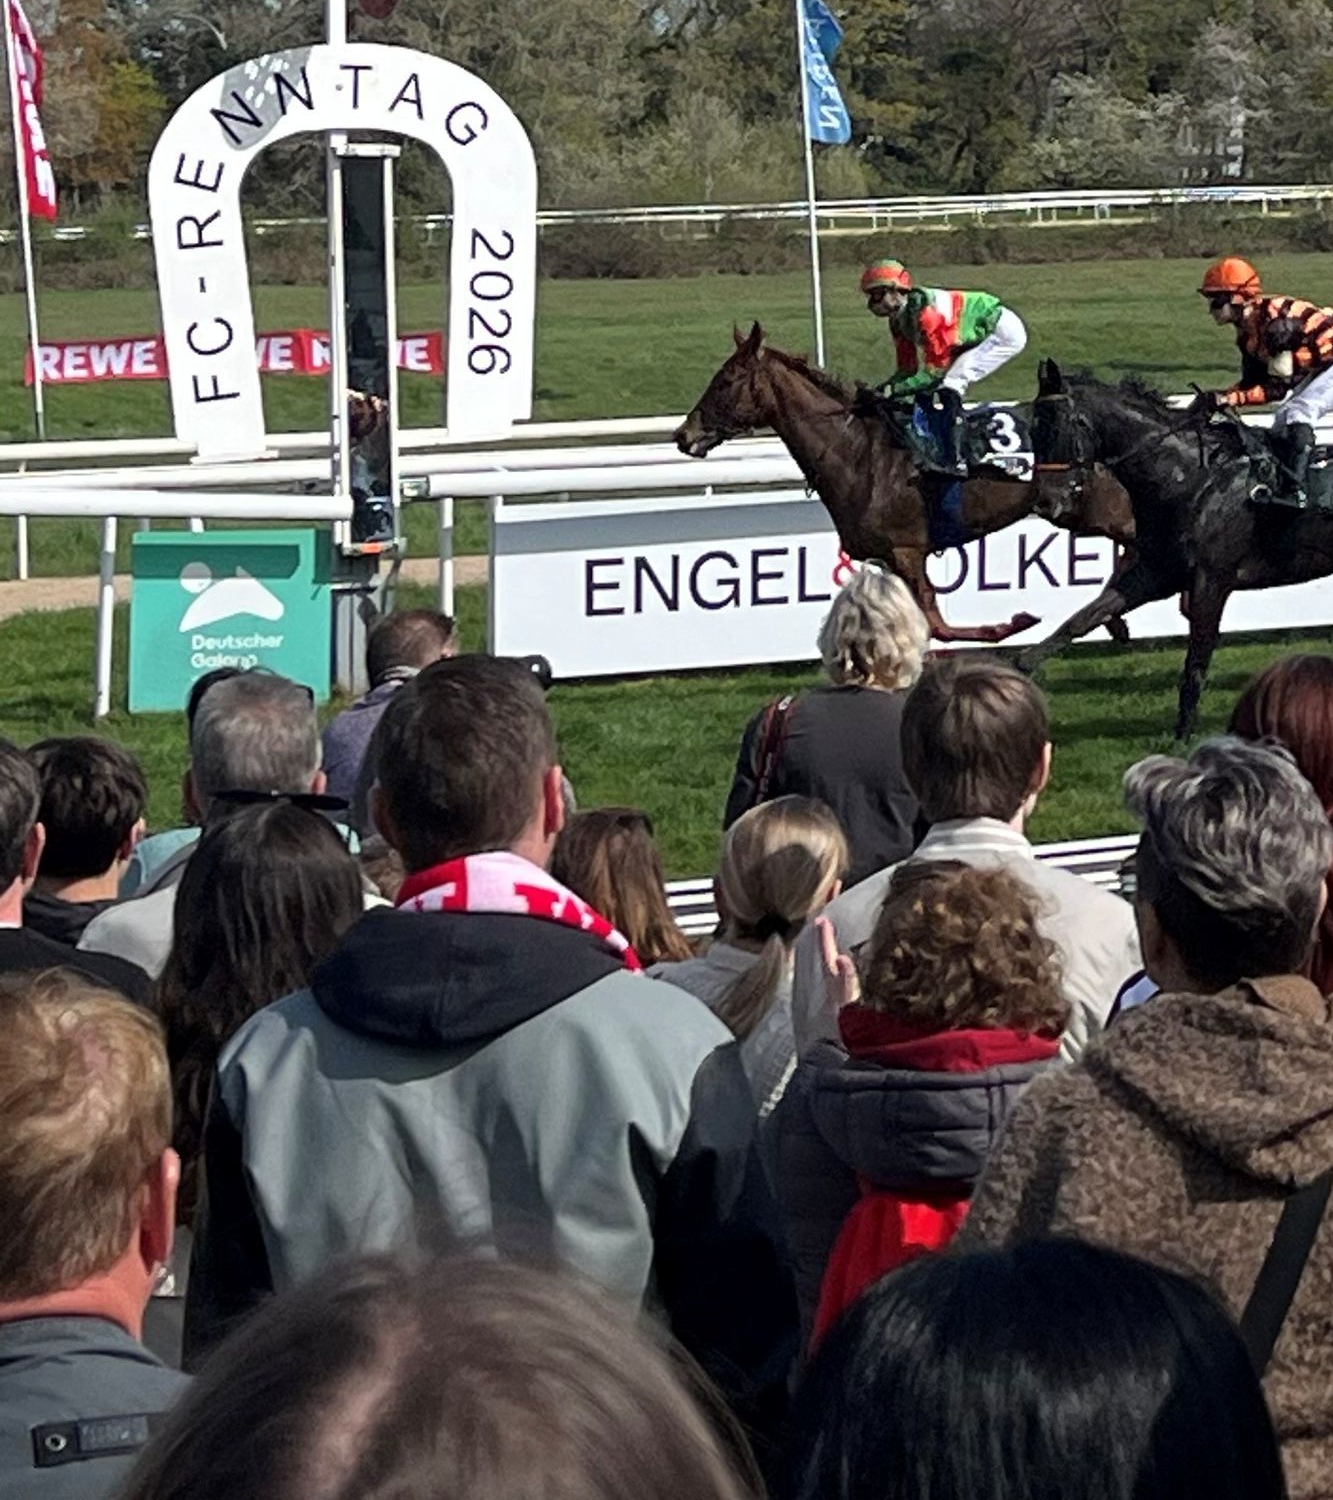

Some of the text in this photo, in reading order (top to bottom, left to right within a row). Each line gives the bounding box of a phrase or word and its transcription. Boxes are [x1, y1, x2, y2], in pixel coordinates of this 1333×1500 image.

[467, 227, 515, 376] 2026
[37, 337, 158, 380] REWE
[987, 412, 1022, 452] 3
[190, 633, 284, 651] Deutscher
